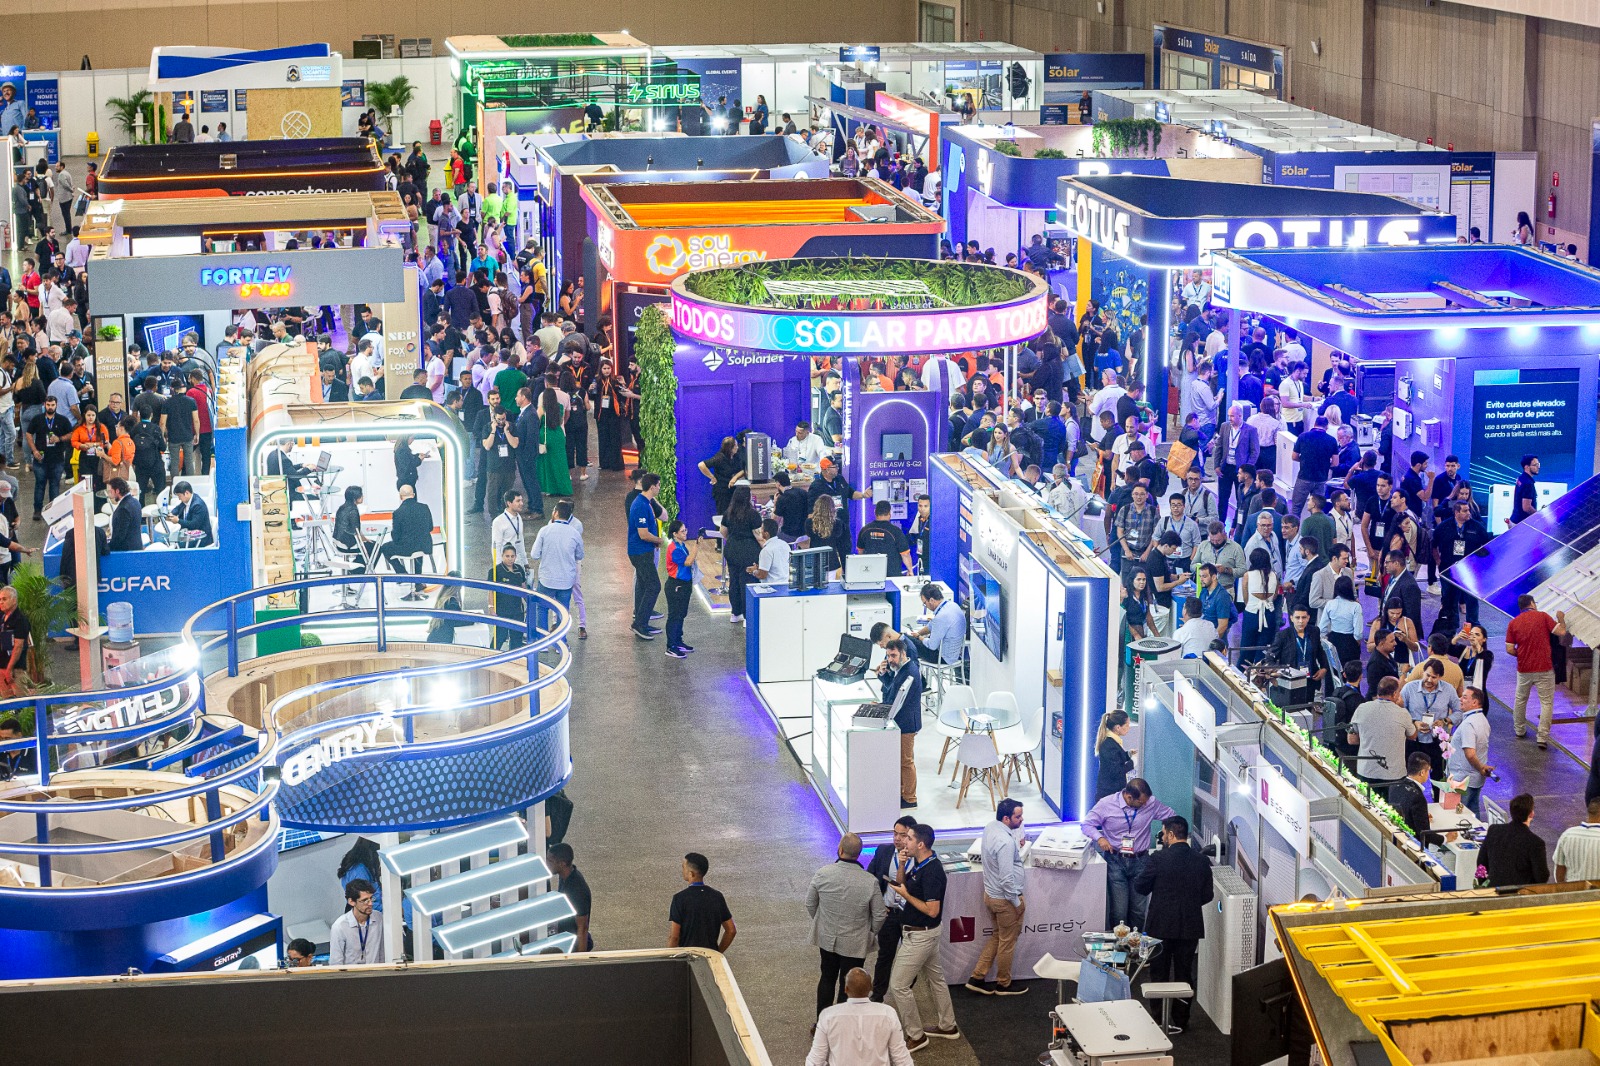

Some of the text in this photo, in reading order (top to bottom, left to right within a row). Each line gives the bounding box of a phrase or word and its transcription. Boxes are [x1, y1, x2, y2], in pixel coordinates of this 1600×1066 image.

[1178, 36, 1193, 49] SAÍDA
[1204, 40, 1220, 54] solar
[1241, 50, 1257, 63] SAÍDA
[1049, 66, 1079, 77] solar
[1281, 165, 1309, 176] solar
[1451, 163, 1473, 172] solar
[1066, 187, 1131, 255] FOTUS
[688, 235, 730, 252] sou
[201, 266, 292, 286] FORTLEV
[675, 300, 735, 341] TODOS
[795, 318, 907, 348] SOLAR
[915, 314, 991, 346] PARA
[997, 300, 1047, 338] TODOS
[388, 332, 417, 341] NEP
[388, 347, 405, 355] FOX
[1486, 399, 1566, 409] Evite custos elevados
[1497, 410, 1523, 418] horário
[1536, 409, 1555, 418] pico:
[1501, 423, 1521, 431] energia
[1484, 431, 1506, 439] quando
[97, 576, 171, 593] SOFAR
[1132, 667, 1141, 714] Heineken
